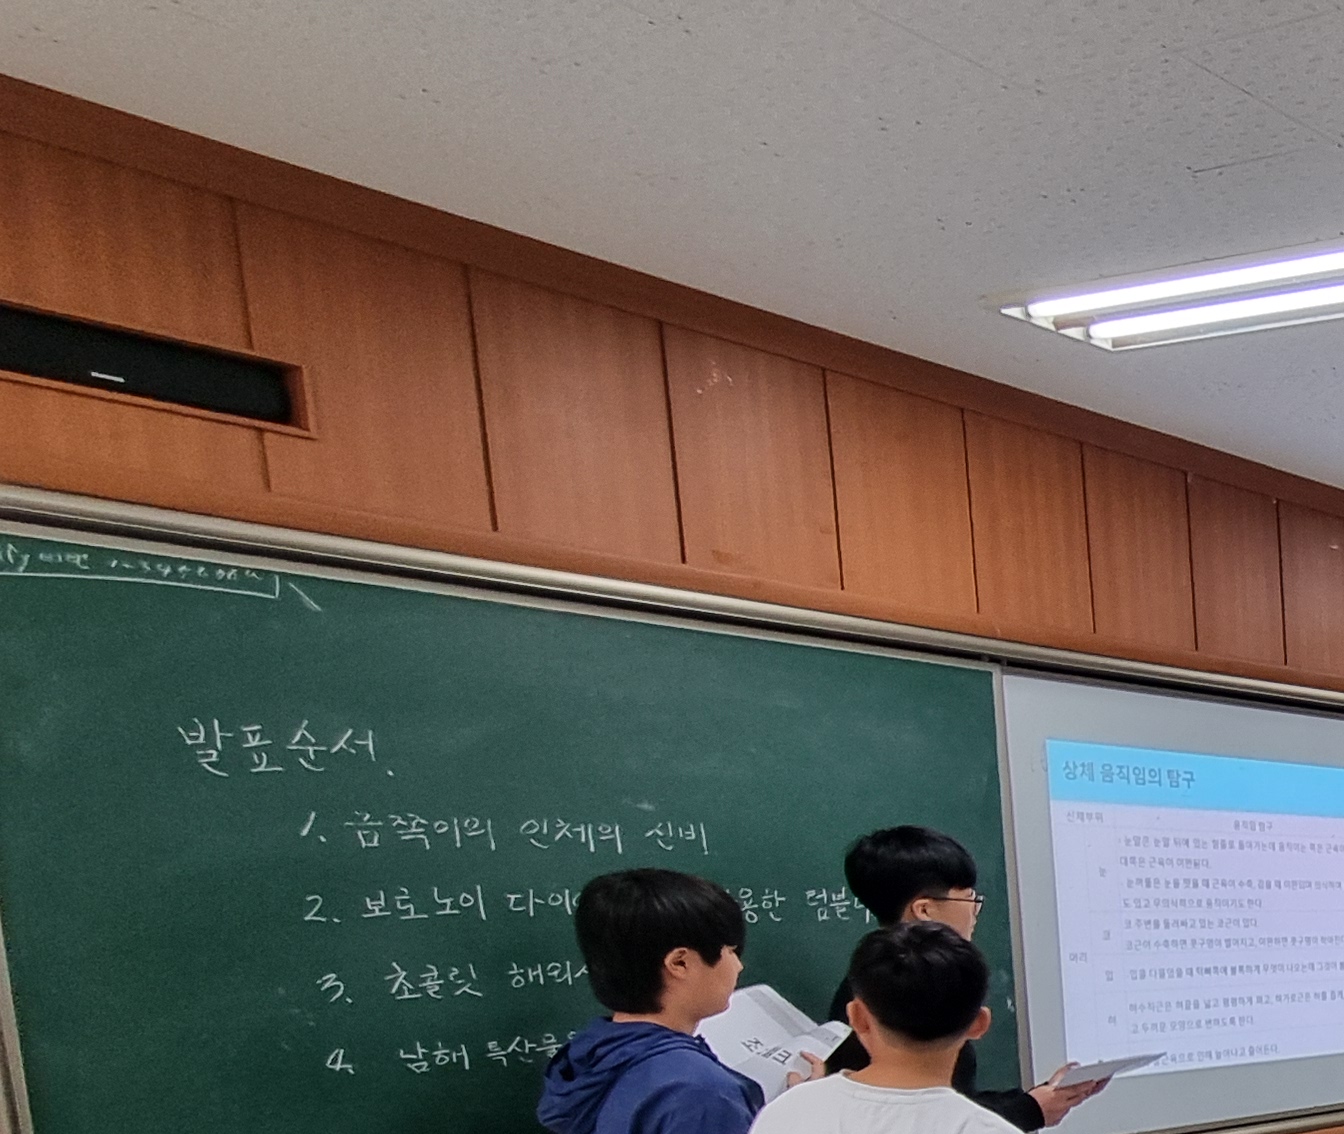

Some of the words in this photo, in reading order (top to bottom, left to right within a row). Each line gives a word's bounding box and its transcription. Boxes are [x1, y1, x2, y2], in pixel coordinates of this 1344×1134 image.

[1062, 760, 1096, 783] 상체
[1100, 762, 1163, 788] 움직임의
[1166, 769, 1197, 790] 탐구
[299, 810, 327, 844] 1.
[518, 816, 623, 854] 인체의
[645, 819, 709, 855] 신비
[303, 894, 341, 923] 2.
[315, 972, 353, 1004] 3.
[384, 961, 483, 1000] 초콜릿
[399, 1041, 470, 1073] 남해
